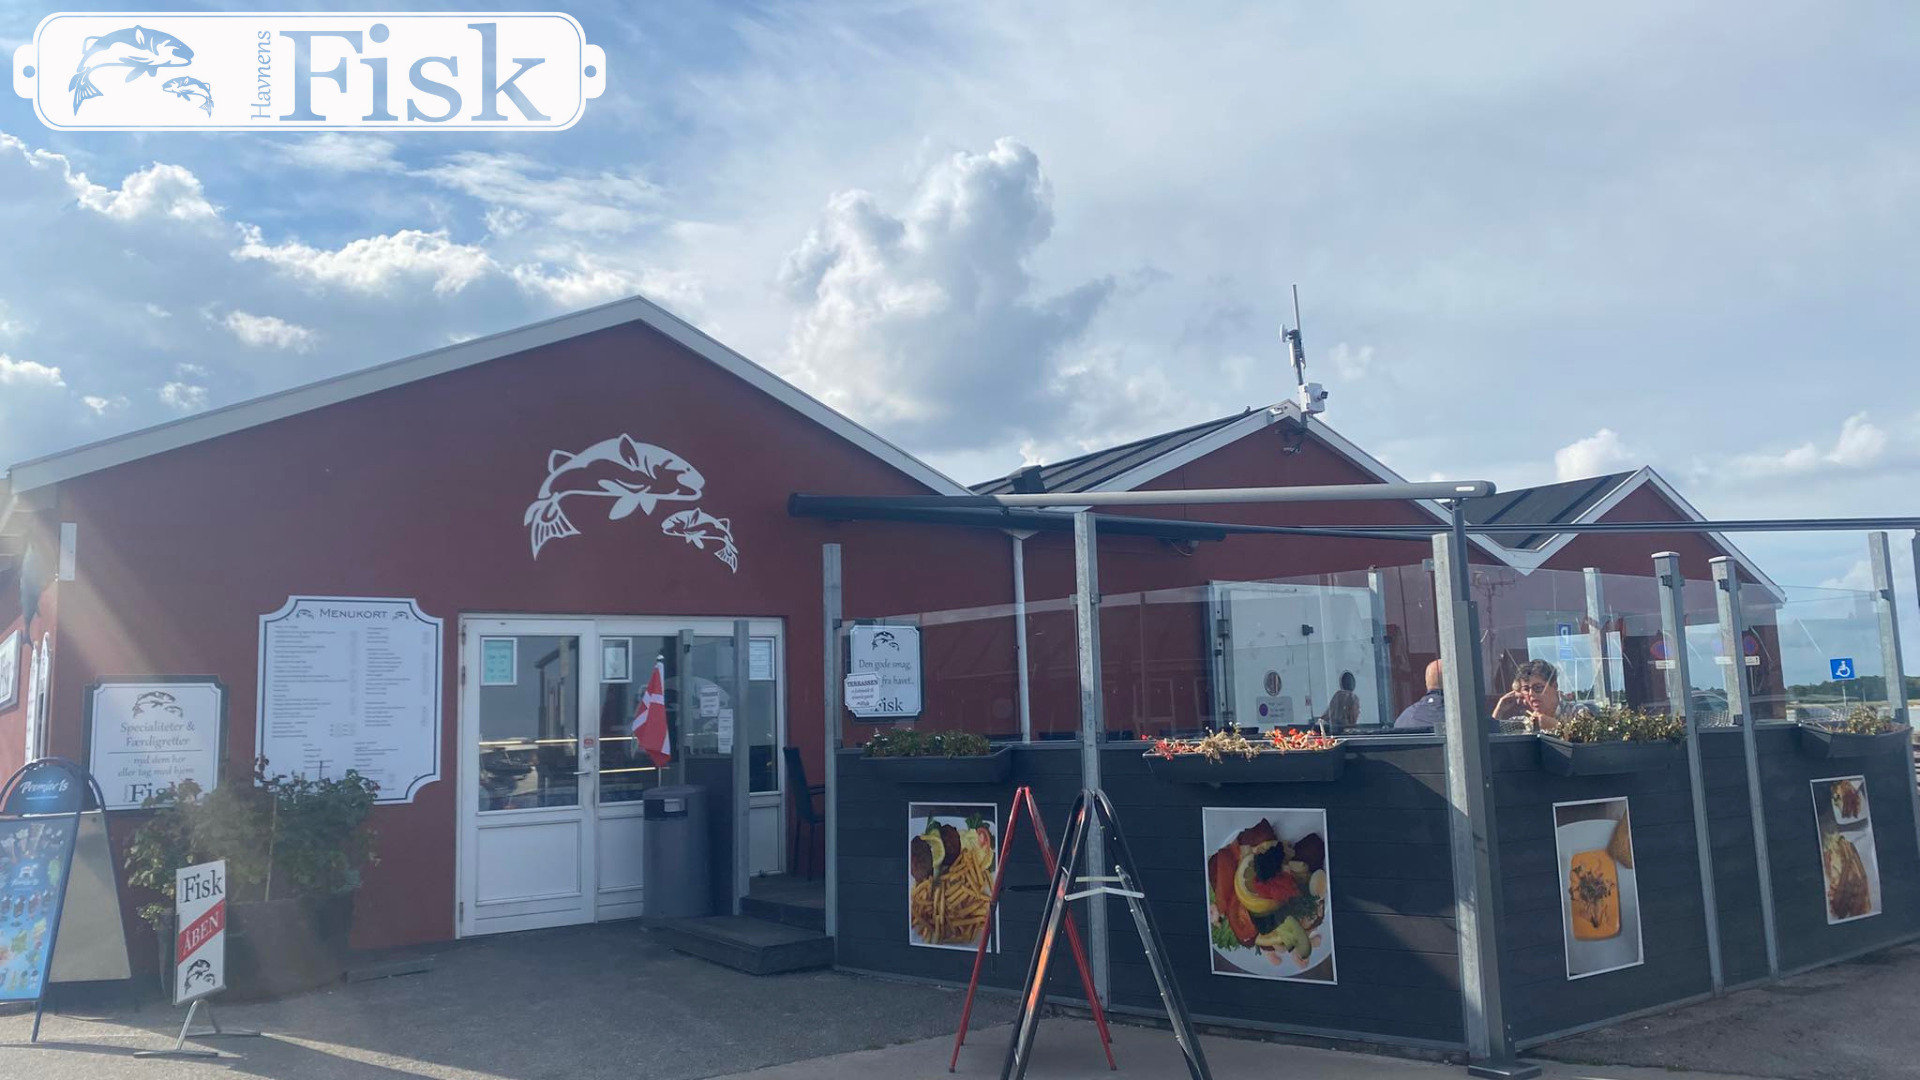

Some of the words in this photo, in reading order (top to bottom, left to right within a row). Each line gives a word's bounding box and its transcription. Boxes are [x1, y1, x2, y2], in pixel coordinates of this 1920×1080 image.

[858, 659, 873, 668] Den
[120, 720, 184, 735] Specialiteter
[186, 720, 195, 731] &
[183, 870, 223, 903] Fisk
